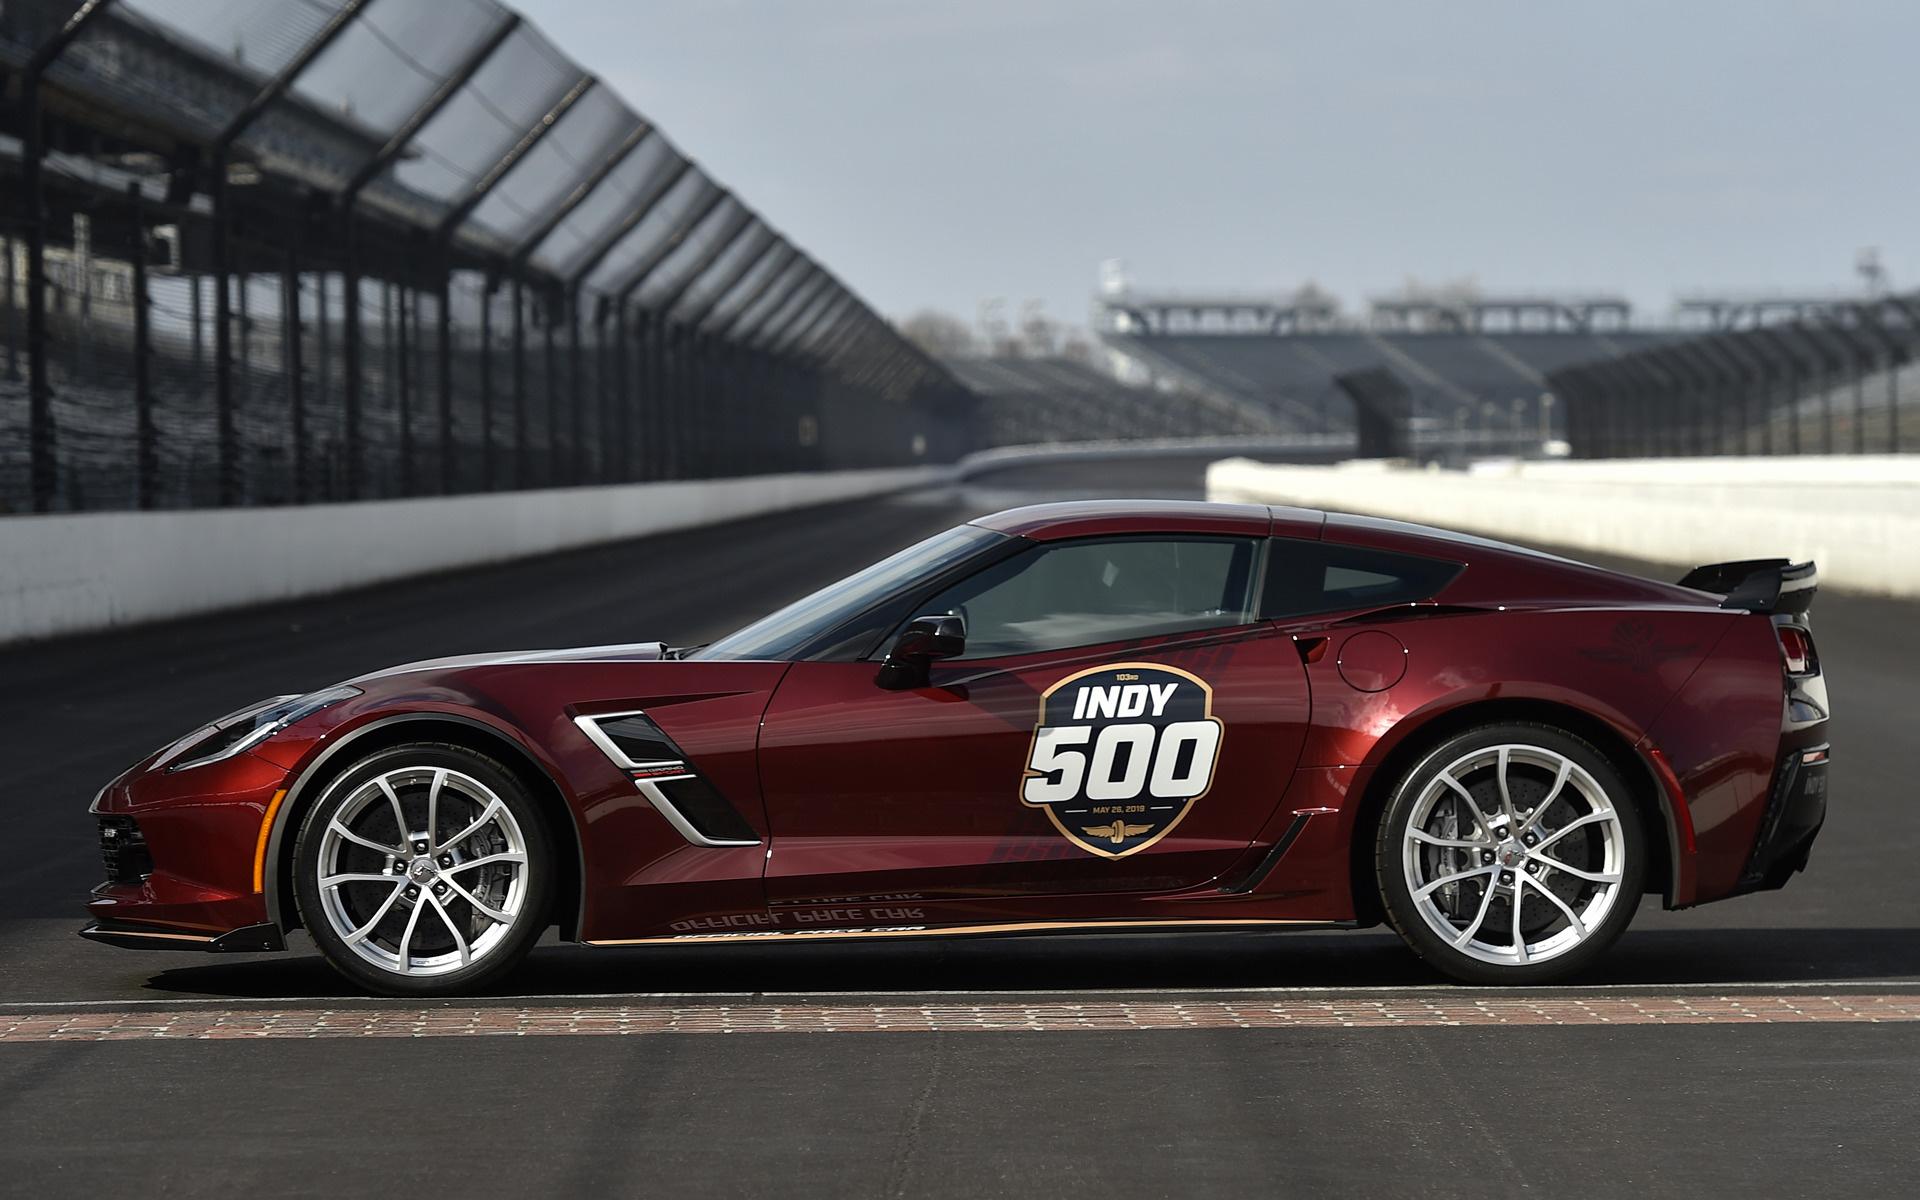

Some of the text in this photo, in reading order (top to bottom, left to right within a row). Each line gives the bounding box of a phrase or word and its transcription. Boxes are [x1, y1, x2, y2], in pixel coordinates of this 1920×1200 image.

[1072, 683, 1179, 720] INDY
[1024, 720, 1220, 803] 500
[1093, 806, 1110, 814] MAY
[1125, 805, 1145, 813] 2019
